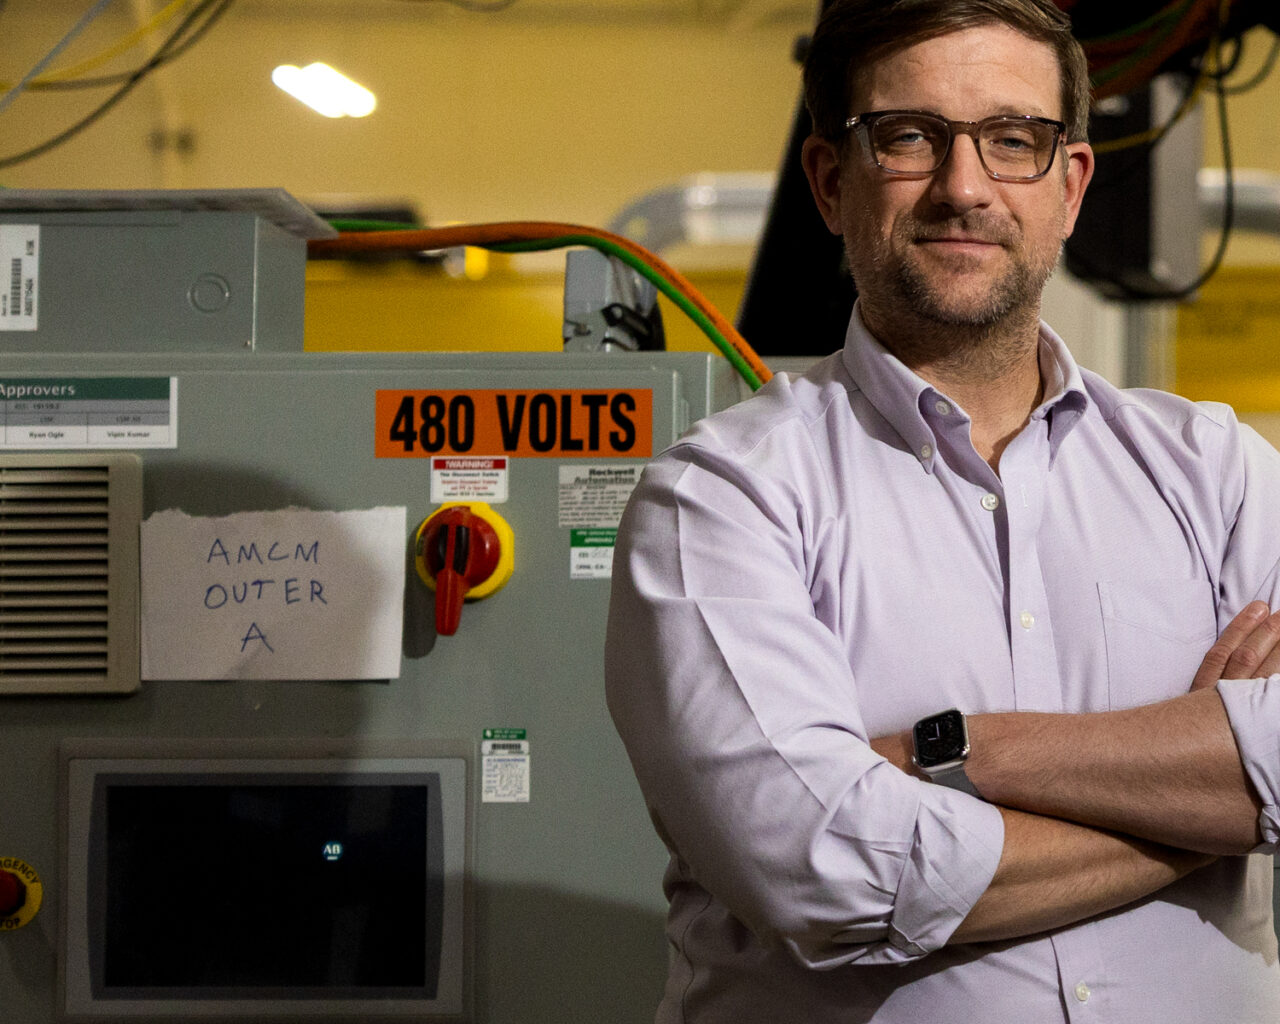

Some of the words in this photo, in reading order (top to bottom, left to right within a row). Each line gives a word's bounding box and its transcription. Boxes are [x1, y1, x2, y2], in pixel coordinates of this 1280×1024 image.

[390, 395, 475, 452] 480
[496, 393, 636, 452] VOLTS
[574, 476, 635, 484] Automation
[207, 538, 319, 566] AMCM
[204, 578, 327, 609] OUTER
[240, 622, 274, 653] A
